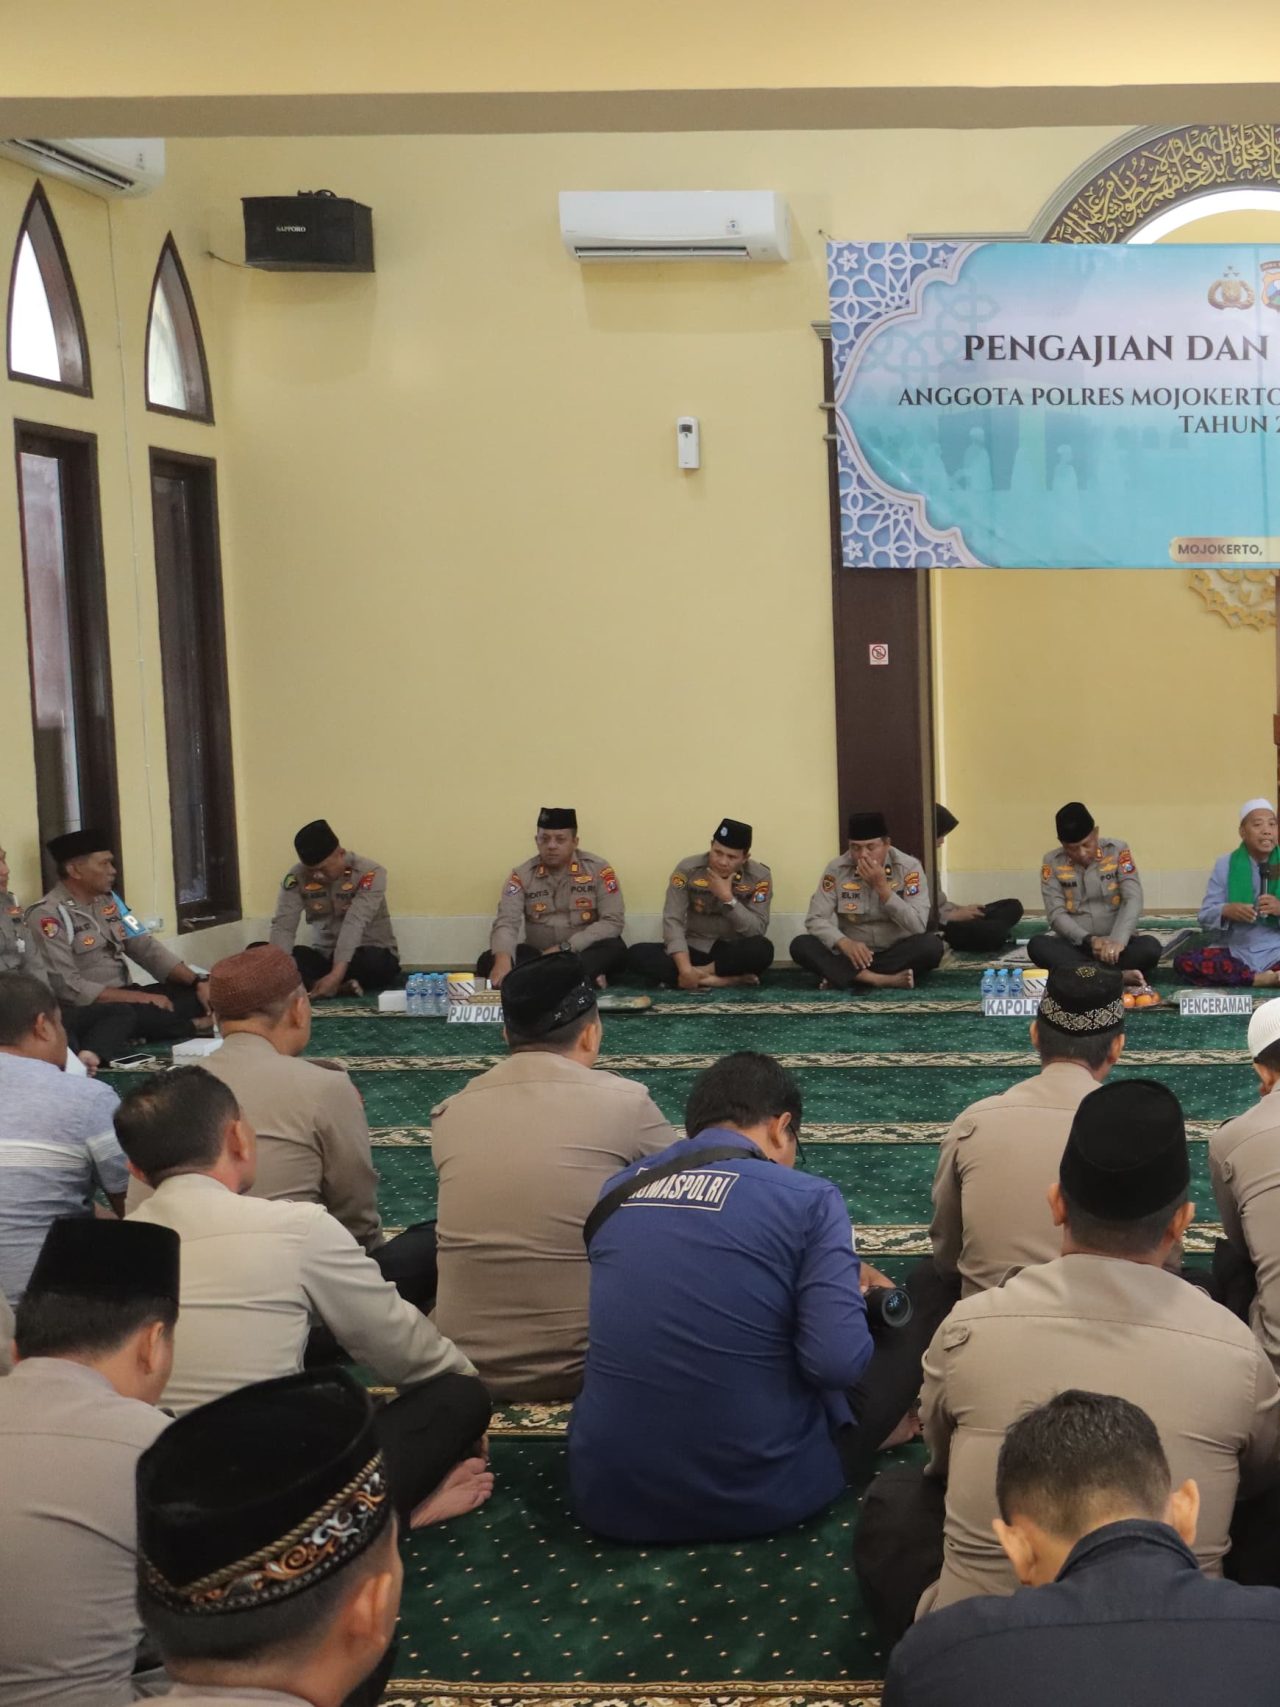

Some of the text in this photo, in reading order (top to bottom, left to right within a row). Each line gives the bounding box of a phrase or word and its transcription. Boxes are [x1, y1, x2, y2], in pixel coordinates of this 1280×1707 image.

[964, 335, 1173, 367] PENGAJIAN
[1187, 335, 1269, 361] DAN
[899, 387, 1023, 406] ANGGOTA
[1032, 387, 1124, 406] POLRES
[1179, 415, 1268, 434] TAHUN
[1178, 544, 1263, 556] MOJOKERTO,
[449, 1007, 472, 1021] PJU
[1181, 997, 1251, 1014] PENCERAMAH
